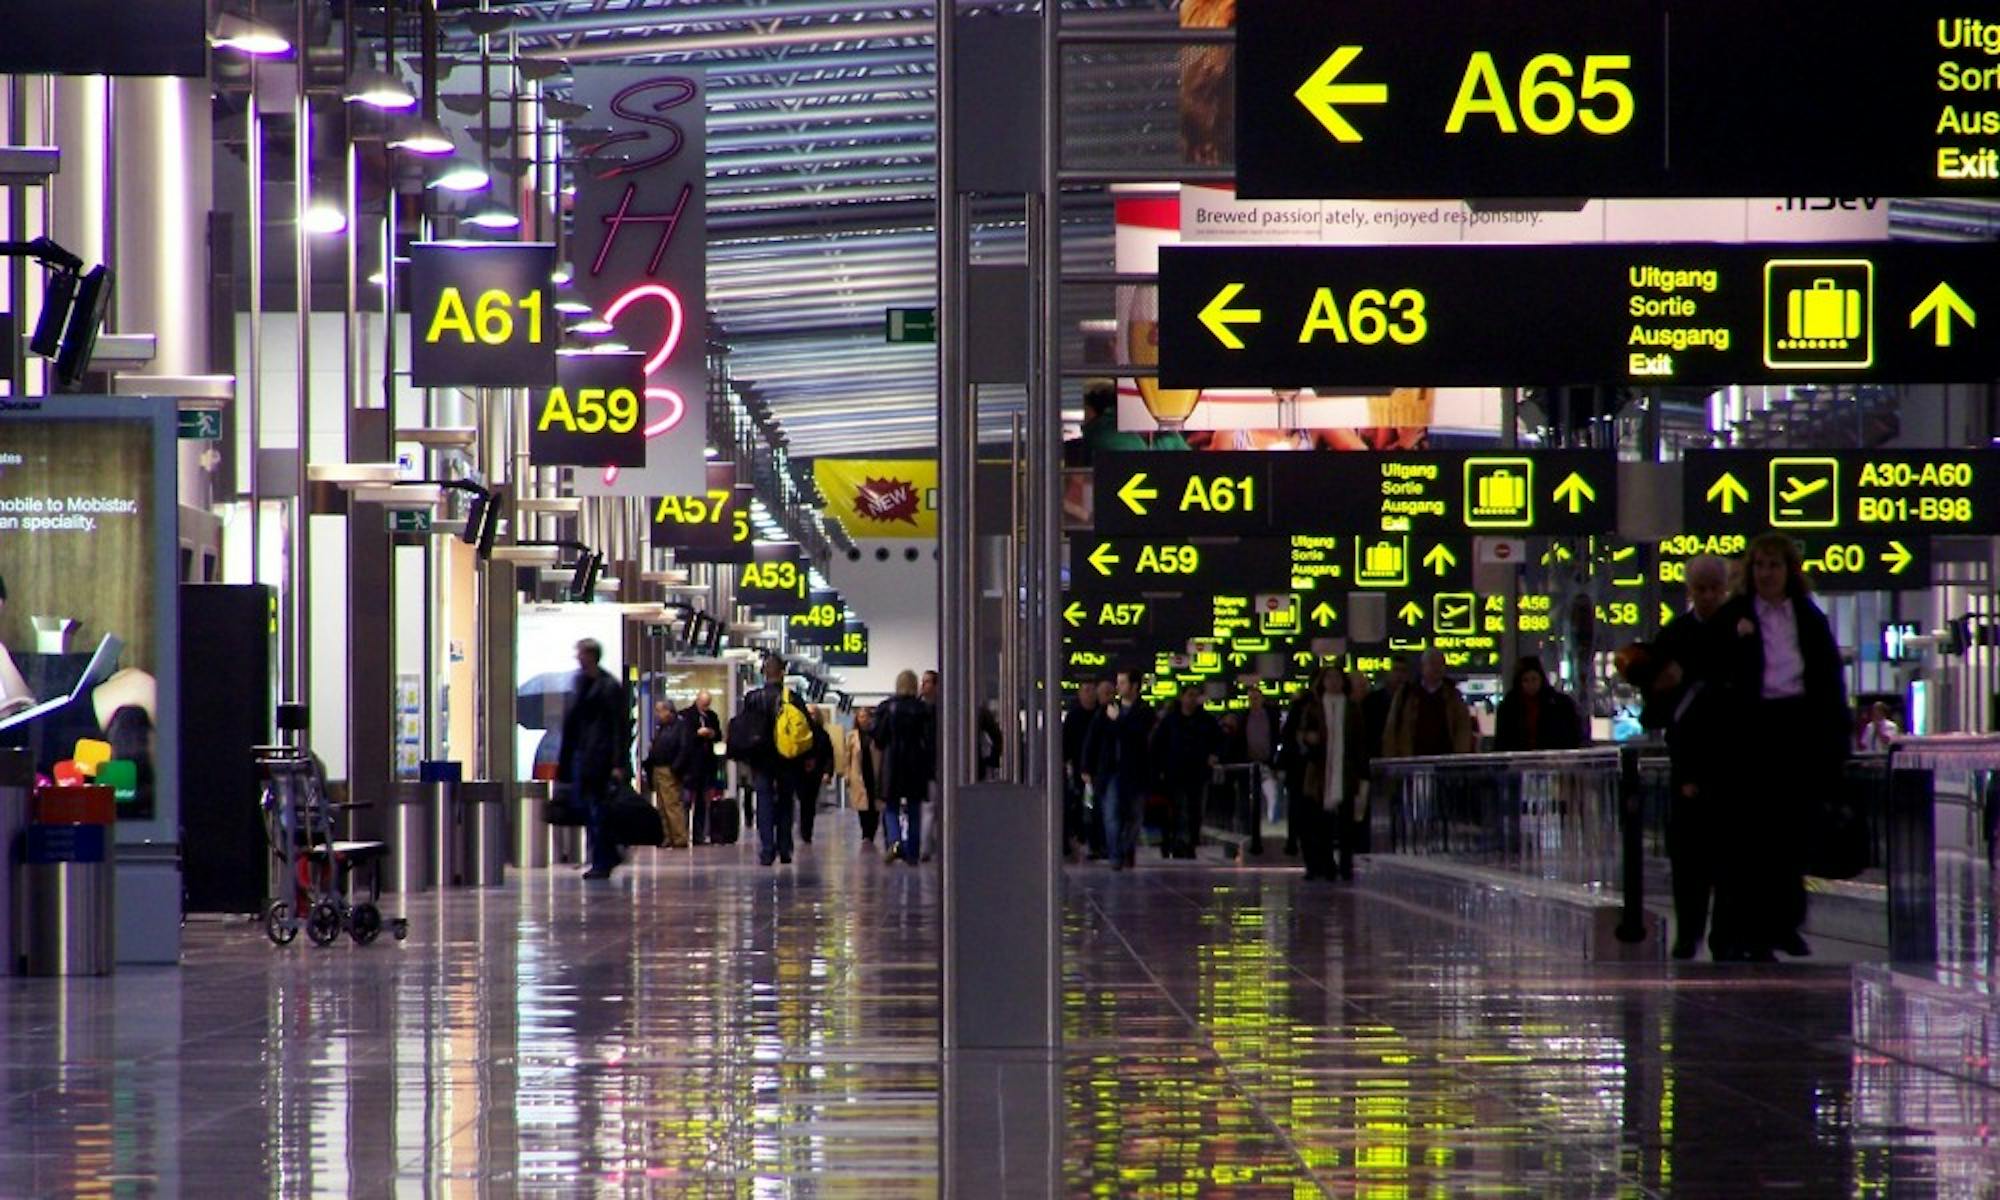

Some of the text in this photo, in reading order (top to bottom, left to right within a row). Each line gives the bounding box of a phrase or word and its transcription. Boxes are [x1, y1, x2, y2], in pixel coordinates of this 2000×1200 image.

[1445, 52, 1634, 134] A65
[1938, 148, 1999, 178] Exit
[1196, 208, 1257, 223] Brewed
[1374, 207, 1439, 228] enjoyed
[1629, 266, 1718, 292] Uitgang
[426, 287, 542, 344] A61
[1299, 287, 1427, 345] A63
[1629, 295, 1697, 316] Sortie
[1628, 325, 1730, 351] Ausgang
[1629, 353, 1673, 375] Exit
[538, 388, 639, 433] A59
[1381, 463, 1438, 479] Uitgang
[1858, 462, 1973, 487] A30-A60
[866, 484, 908, 517] NEW
[1180, 476, 1254, 512] A61
[1381, 481, 1424, 495] Sortie
[47, 499, 64, 512] to
[67, 497, 138, 514] Mobistar,
[655, 489, 730, 524] A57
[1381, 499, 1445, 515] Ausgang
[1858, 497, 1973, 521] B01-B98
[22, 514, 97, 531] speciality.
[1136, 545, 1199, 573] A59
[740, 562, 796, 589] A53
[1099, 603, 1145, 625] A57
